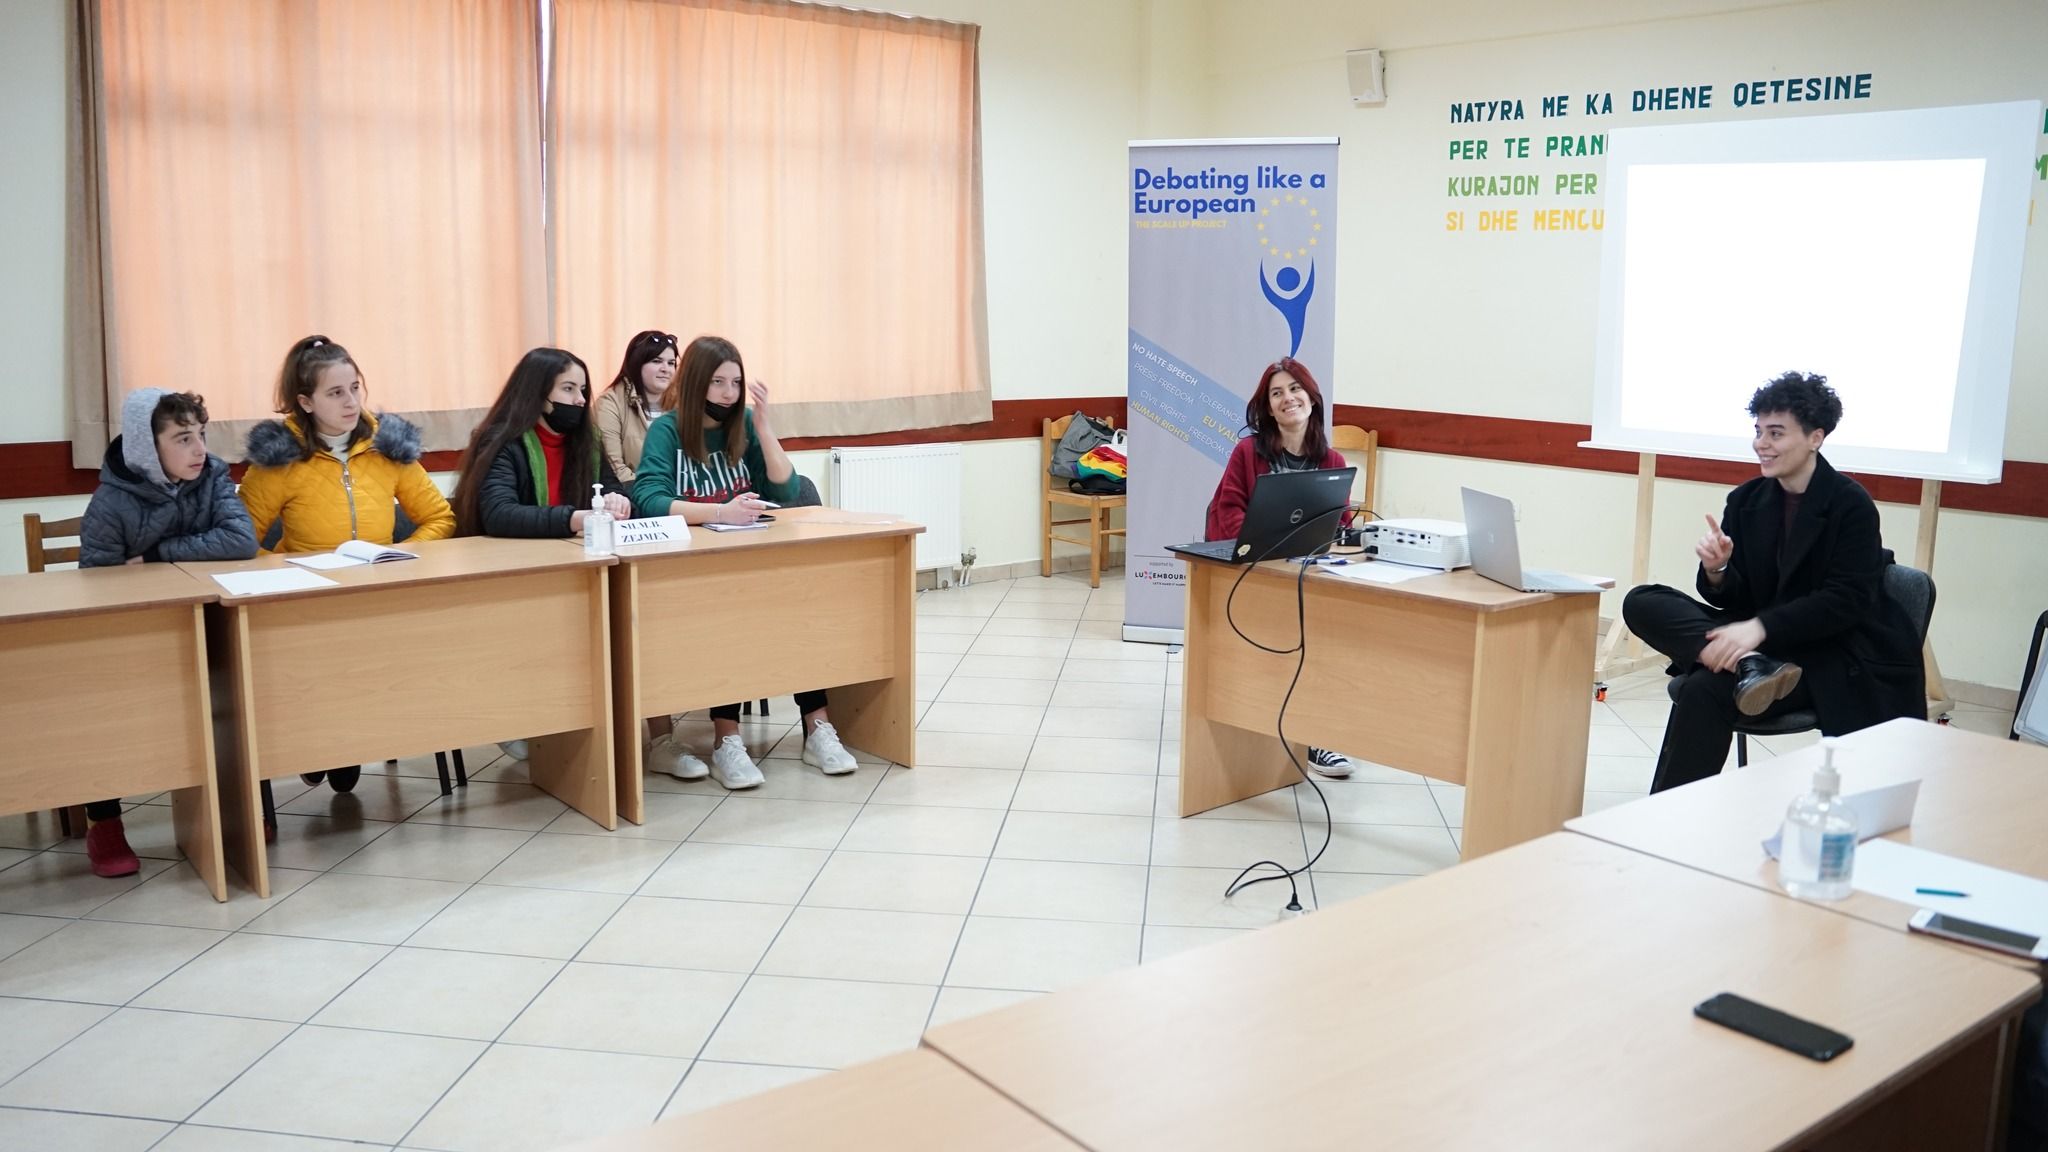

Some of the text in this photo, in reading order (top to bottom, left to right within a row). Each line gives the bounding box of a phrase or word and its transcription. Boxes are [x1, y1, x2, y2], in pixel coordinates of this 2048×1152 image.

[1450, 73, 1873, 123] NATYRA ME KA DHENE QETESINE
[1449, 134, 1609, 160] PER TE PRAN
[1134, 165, 1326, 196] Debating like a
[1447, 173, 1599, 197] KURAJON PER
[1134, 192, 1256, 219] European
[1446, 211, 1464, 231] SI
[1478, 209, 1519, 231] DHE
[1132, 343, 1199, 386] NO HATE SPEECH
[1134, 362, 1195, 405] PRESS FREEDOM
[1131, 400, 1191, 442] HUMAN RIGHTS
[1140, 390, 1187, 423] CIVIL RIGHTS
[1199, 392, 1243, 425] TOLERANCE
[1201, 415, 1218, 429] EU
[1187, 425, 1224, 455] FREEDOM
